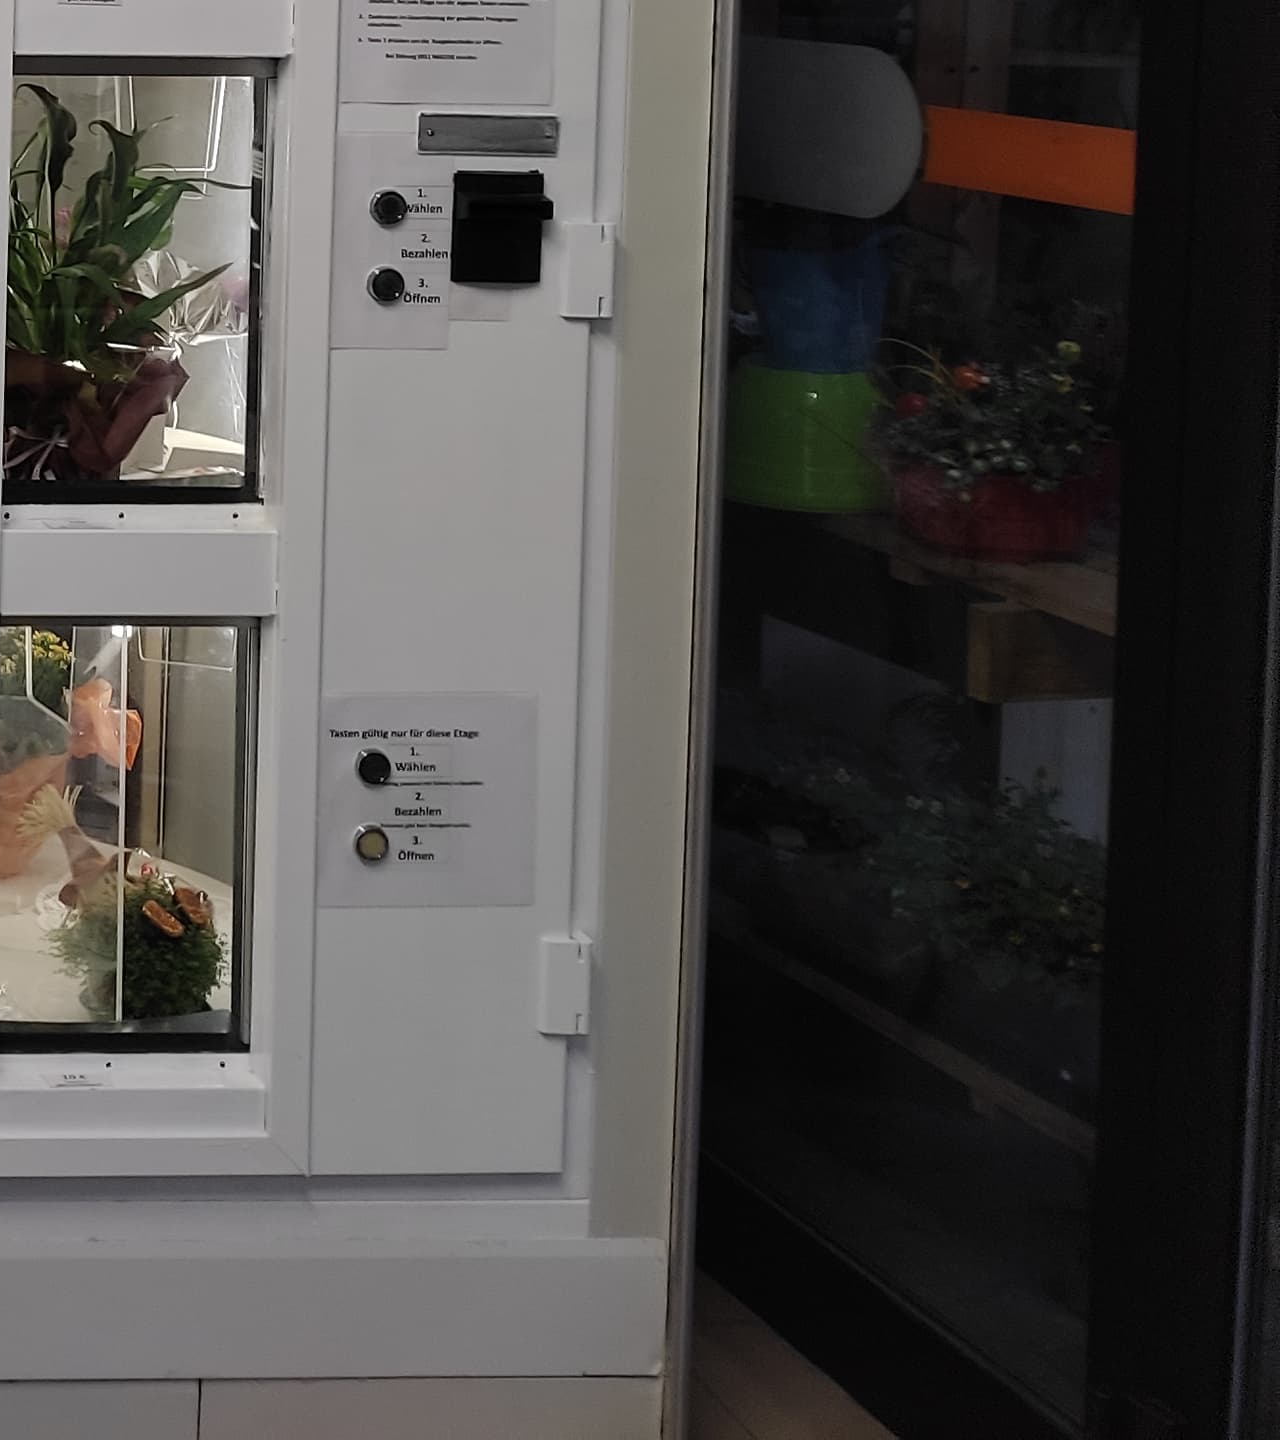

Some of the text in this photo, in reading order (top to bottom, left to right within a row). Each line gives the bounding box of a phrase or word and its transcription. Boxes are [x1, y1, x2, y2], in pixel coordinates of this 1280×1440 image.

[417, 189, 427, 198] 1.
[421, 234, 431, 243] 2.
[401, 248, 448, 260] Bezahlen
[417, 278, 428, 288] 3.
[403, 292, 441, 304] Öffnen
[329, 728, 360, 738] Tasten
[361, 728, 389, 739] gültig
[391, 730, 407, 738] nur
[409, 728, 423, 738] für
[453, 729, 479, 739] Etage
[410, 747, 419, 756] 1.
[395, 762, 436, 772] Wählen
[415, 792, 424, 801] 2.
[394, 807, 442, 817] Bezahlen
[412, 836, 422, 845] 3.
[398, 850, 435, 861] Öffnen
